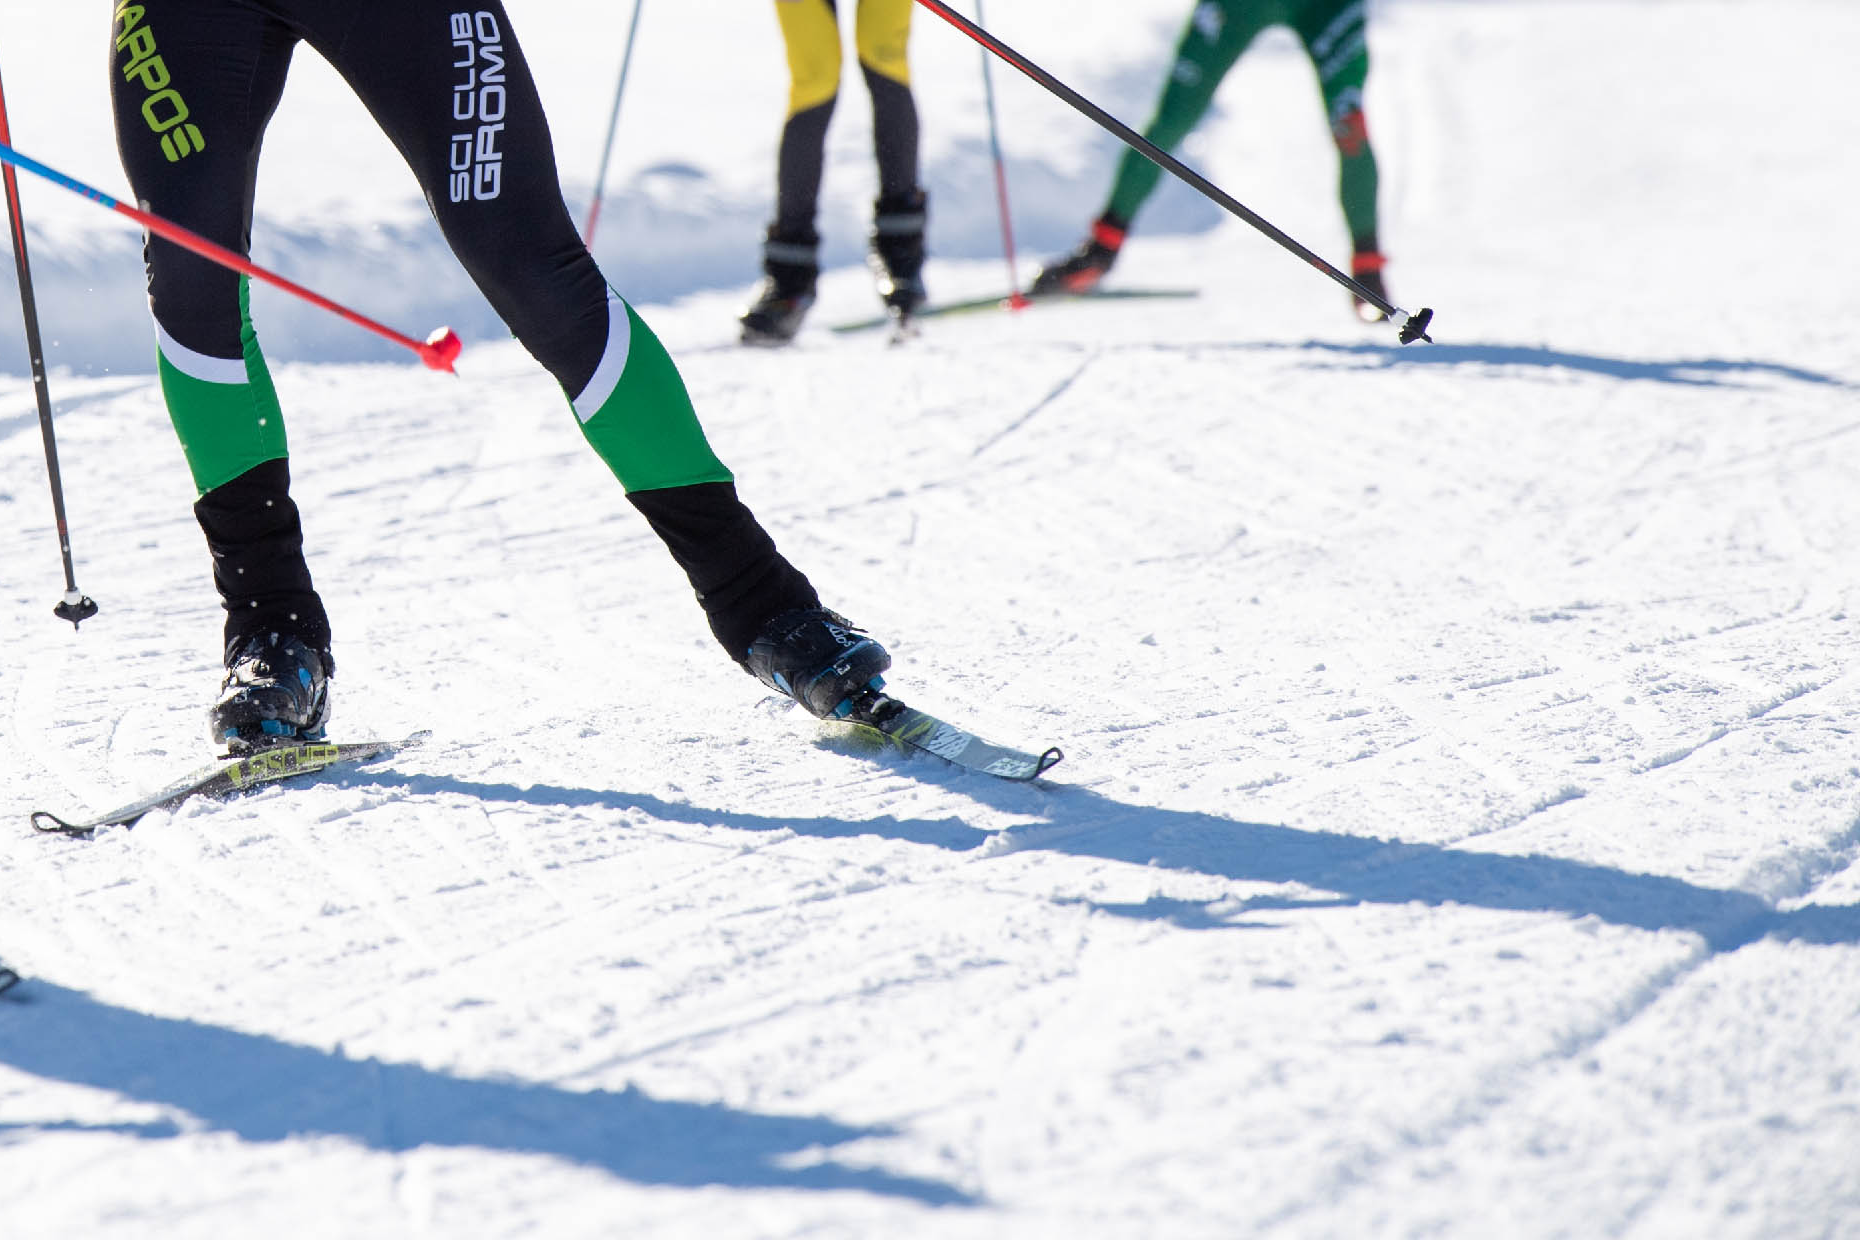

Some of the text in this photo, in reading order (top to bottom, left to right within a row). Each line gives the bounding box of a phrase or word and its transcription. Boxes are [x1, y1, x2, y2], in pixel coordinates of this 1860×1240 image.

[449, 12, 476, 203] SCI CLUB
[473, 10, 507, 201] GROMO
